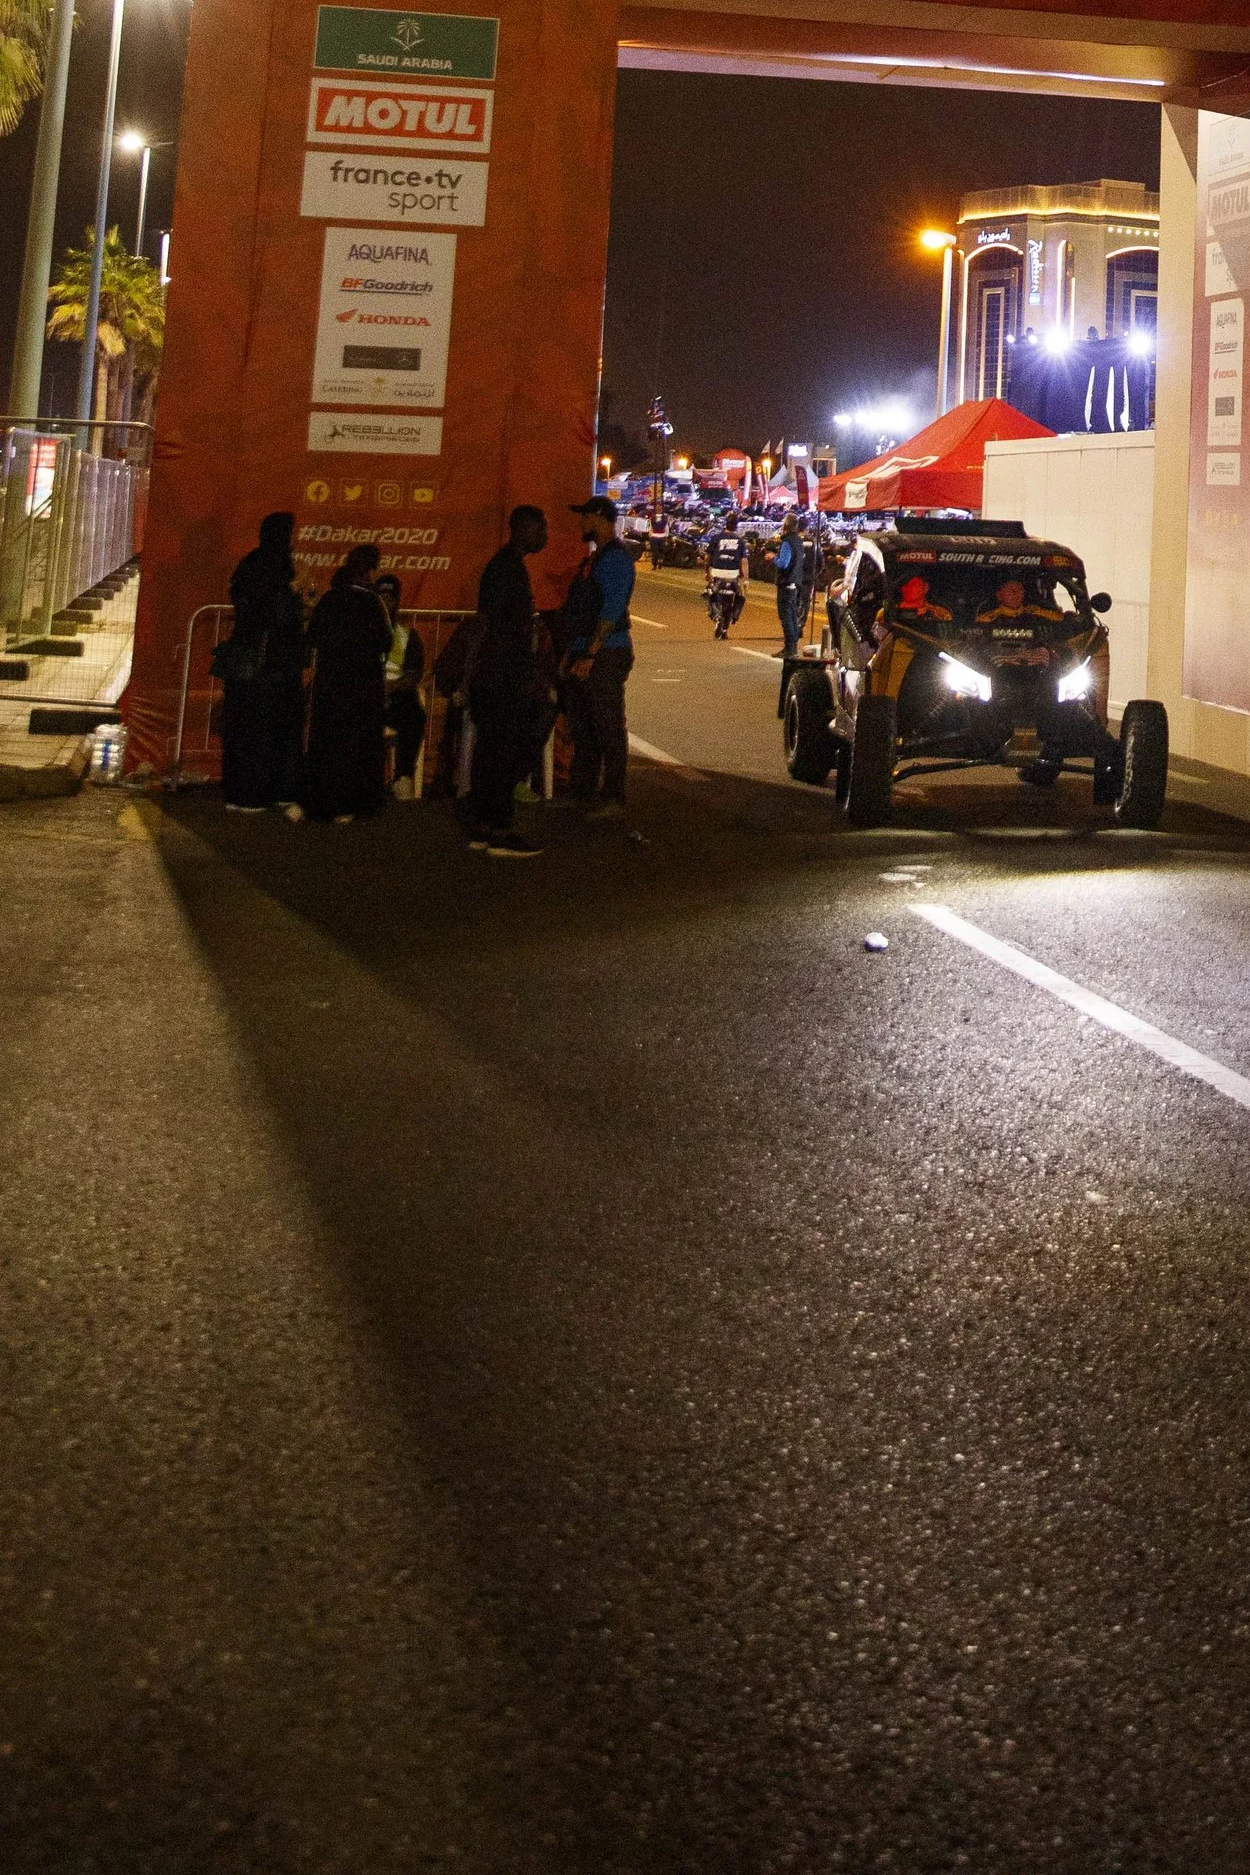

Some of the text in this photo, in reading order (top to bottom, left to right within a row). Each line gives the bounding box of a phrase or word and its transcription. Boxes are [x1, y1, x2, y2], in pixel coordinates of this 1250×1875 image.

[357, 53, 453, 71] SAUDI ARABIA
[323, 95, 478, 135] MOTUL
[388, 191, 459, 215] sport
[1211, 186, 1250, 220] MOTUL
[347, 243, 430, 265] AQUAFINA
[340, 277, 434, 293] BFGoodrich
[358, 313, 432, 326] HONDA
[298, 524, 439, 545] #Dakar2020
[899, 551, 934, 561] MOTUL
[938, 552, 976, 563] SOUTH
[976, 553, 1042, 566] RCING.COM
